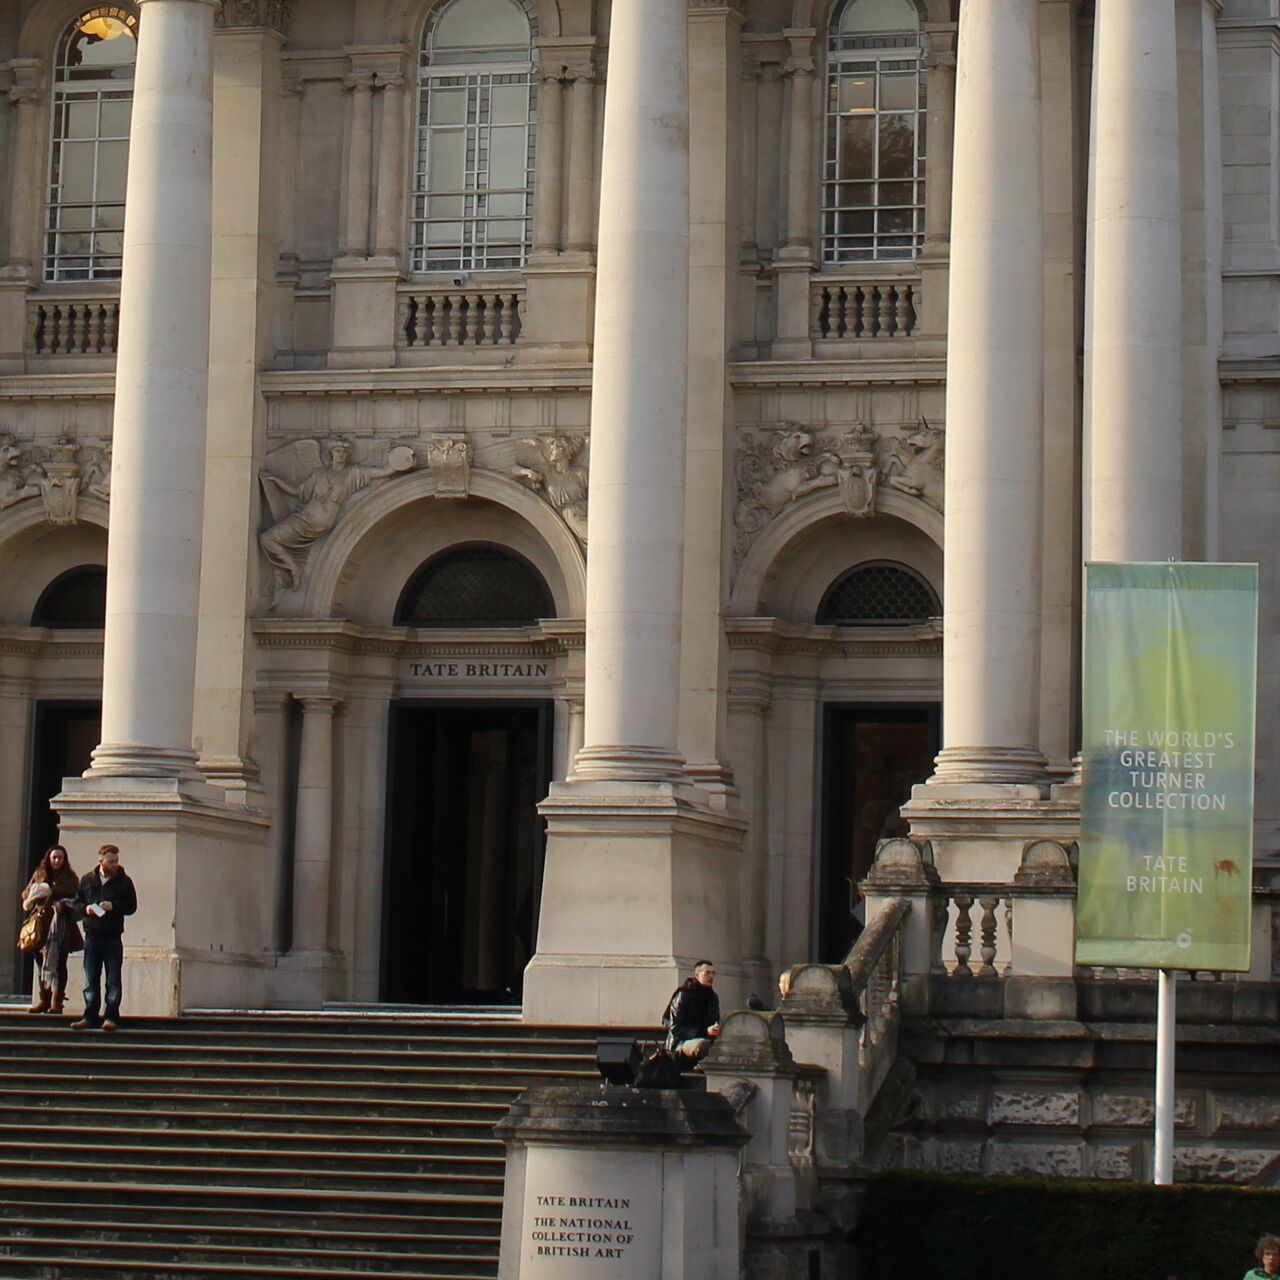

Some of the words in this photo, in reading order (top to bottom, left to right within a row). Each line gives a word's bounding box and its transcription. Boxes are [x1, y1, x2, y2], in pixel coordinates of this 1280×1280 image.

[409, 664, 458, 676] TATE
[465, 664, 548, 677] BRITAIN
[1103, 730, 1138, 747] THE
[1120, 750, 1216, 769] GREATEST
[1129, 771, 1206, 789] TURNER
[1107, 791, 1226, 811] COLLECTION
[1143, 855, 1187, 873] TATE
[1126, 875, 1203, 894] BRITAIN
[537, 1196, 565, 1206] TATE
[569, 1197, 630, 1209] BRITAIN
[534, 1217, 556, 1227] THE
[560, 1218, 632, 1230] NATIONAL
[531, 1231, 612, 1243] COLLECTION
[616, 1234, 634, 1244] OF
[537, 1246, 589, 1257] BRITISH
[594, 1248, 624, 1259] ART
